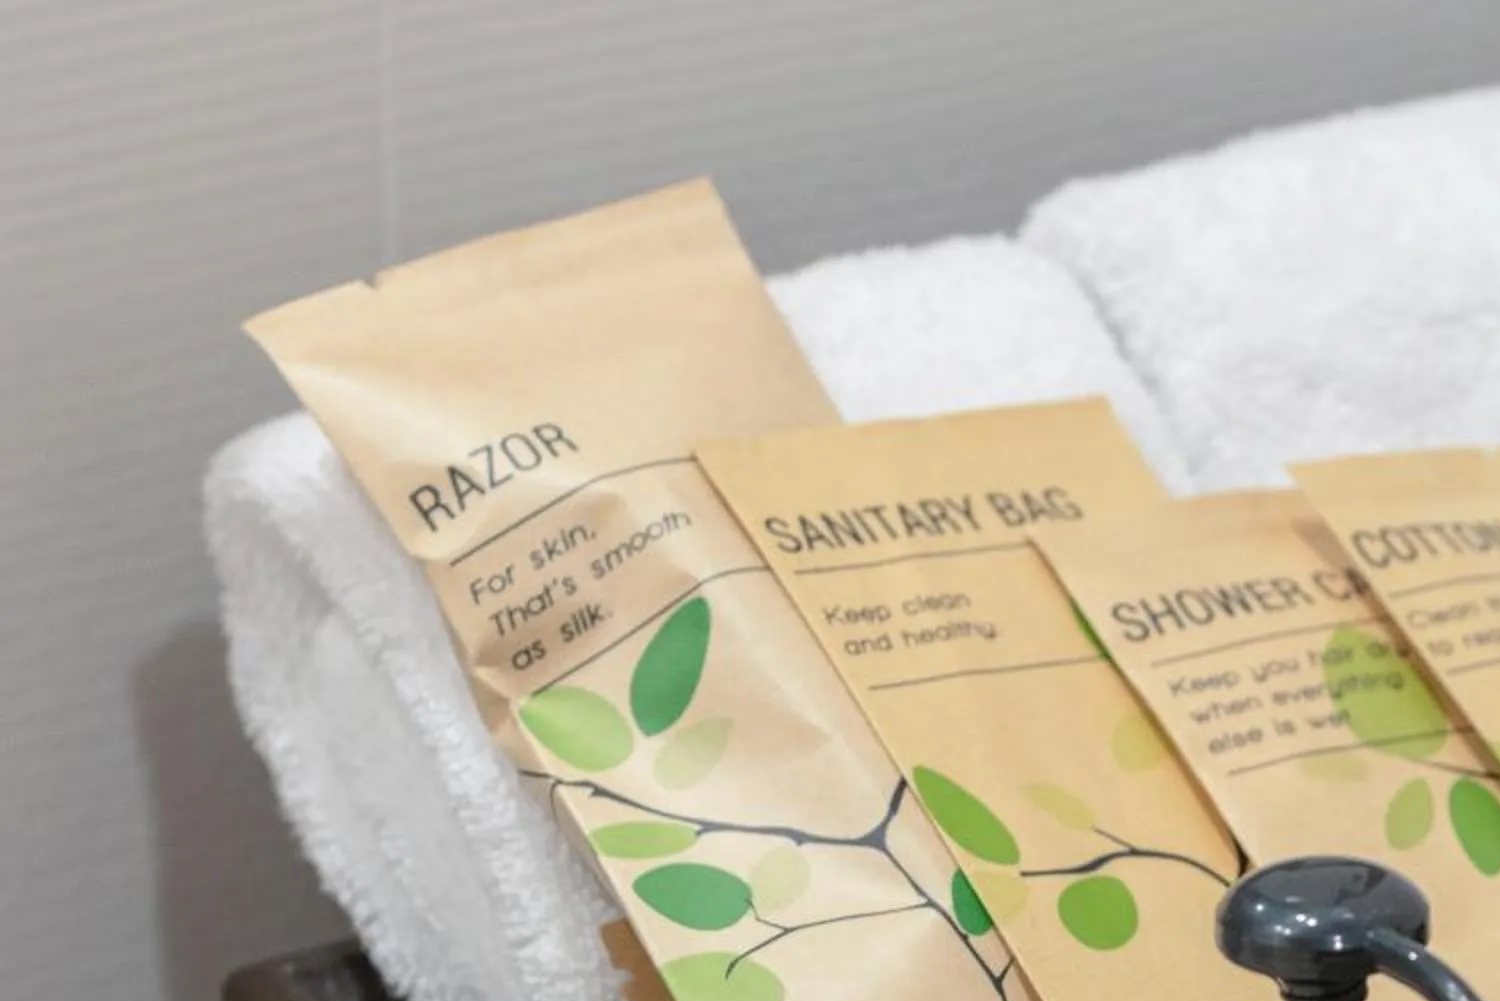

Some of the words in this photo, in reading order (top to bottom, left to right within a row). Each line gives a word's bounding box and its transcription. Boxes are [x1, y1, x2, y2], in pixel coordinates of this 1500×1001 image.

[408, 422, 580, 533] RAZOR
[764, 495, 981, 555] SANITARY
[984, 486, 1084, 528] BAG
[468, 565, 516, 605] For
[489, 576, 578, 637] That's
[589, 511, 693, 580] smooth
[823, 602, 893, 627] Keep
[901, 592, 972, 617] clean
[1110, 576, 1314, 643] SHOWER
[510, 639, 547, 672] as
[844, 632, 894, 657] and
[1168, 669, 1242, 698] Keep
